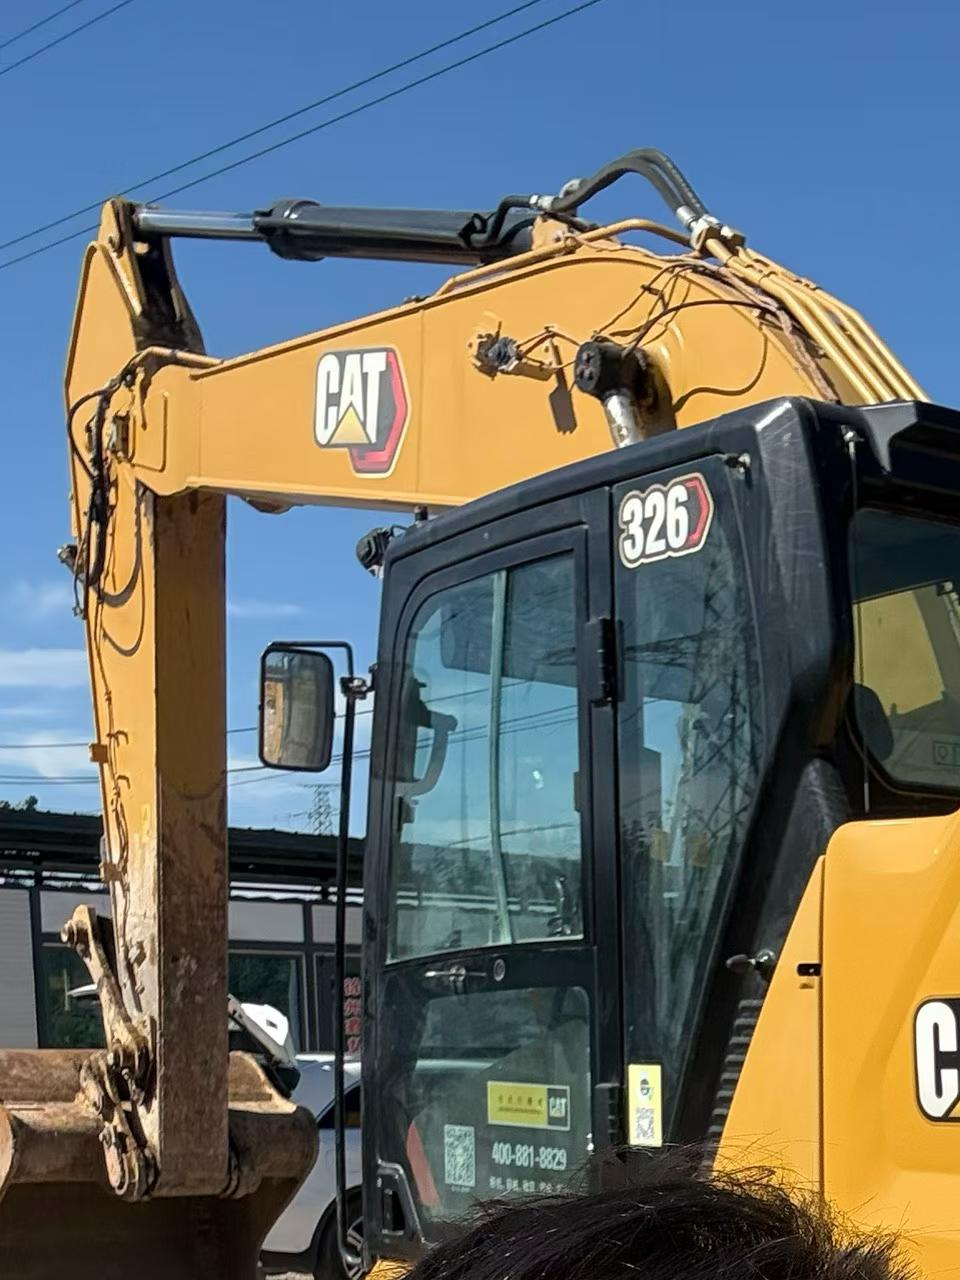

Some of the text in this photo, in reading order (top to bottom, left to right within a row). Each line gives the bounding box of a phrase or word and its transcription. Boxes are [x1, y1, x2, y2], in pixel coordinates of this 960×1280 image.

[315, 351, 387, 445] CAT
[622, 484, 689, 560] 326
[549, 1097, 567, 1118] CAT
[491, 1141, 567, 1171] 400-881-8829
